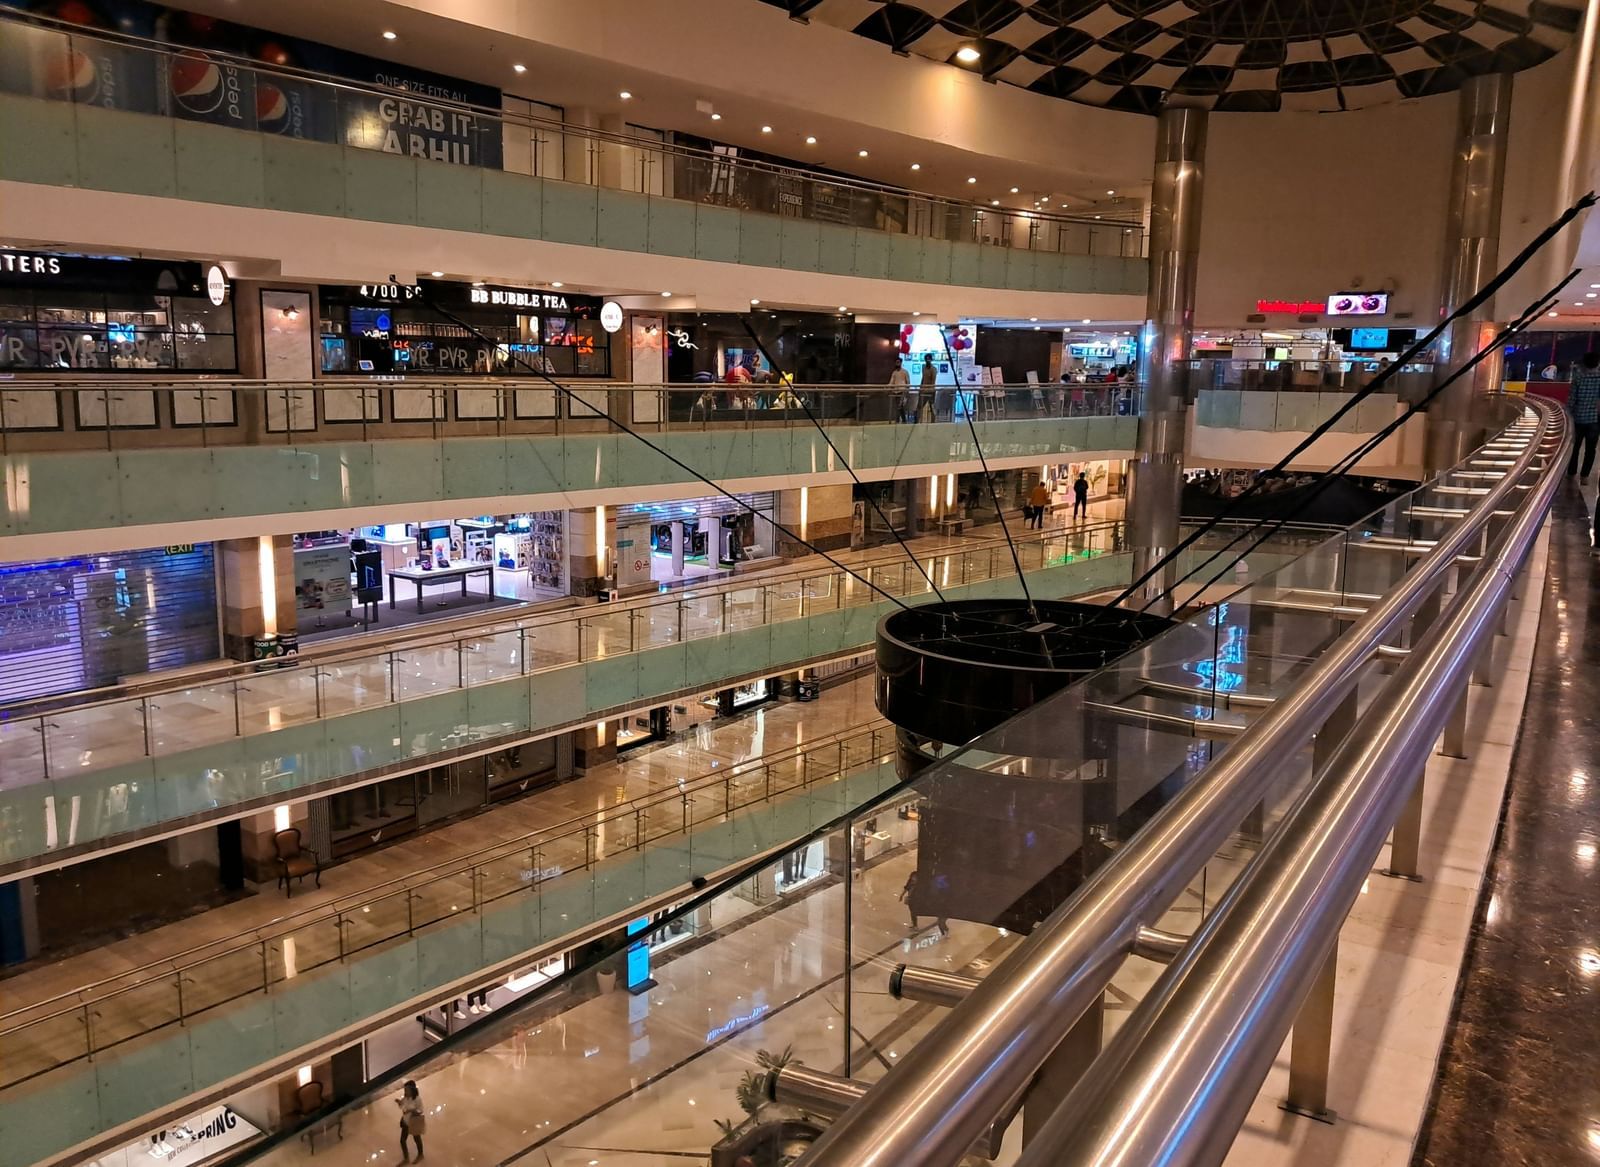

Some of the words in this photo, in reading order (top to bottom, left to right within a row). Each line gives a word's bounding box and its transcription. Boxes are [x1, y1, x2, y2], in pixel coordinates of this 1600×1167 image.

[226, 58, 243, 120] pepsi
[375, 73, 399, 89] ONE
[402, 79, 425, 94] SIZE
[428, 85, 449, 101] FITS
[379, 98, 445, 131] GRAB
[451, 113, 471, 137] IT
[0, 254, 61, 274] TERS
[471, 289, 489, 303] BB
[491, 290, 540, 307] BUBBLE
[543, 295, 568, 309] TEA
[834, 331, 851, 348] PVR
[439, 346, 468, 368] PVR
[170, 544, 193, 554] EXIT
[190, 1108, 237, 1141] SPRING
